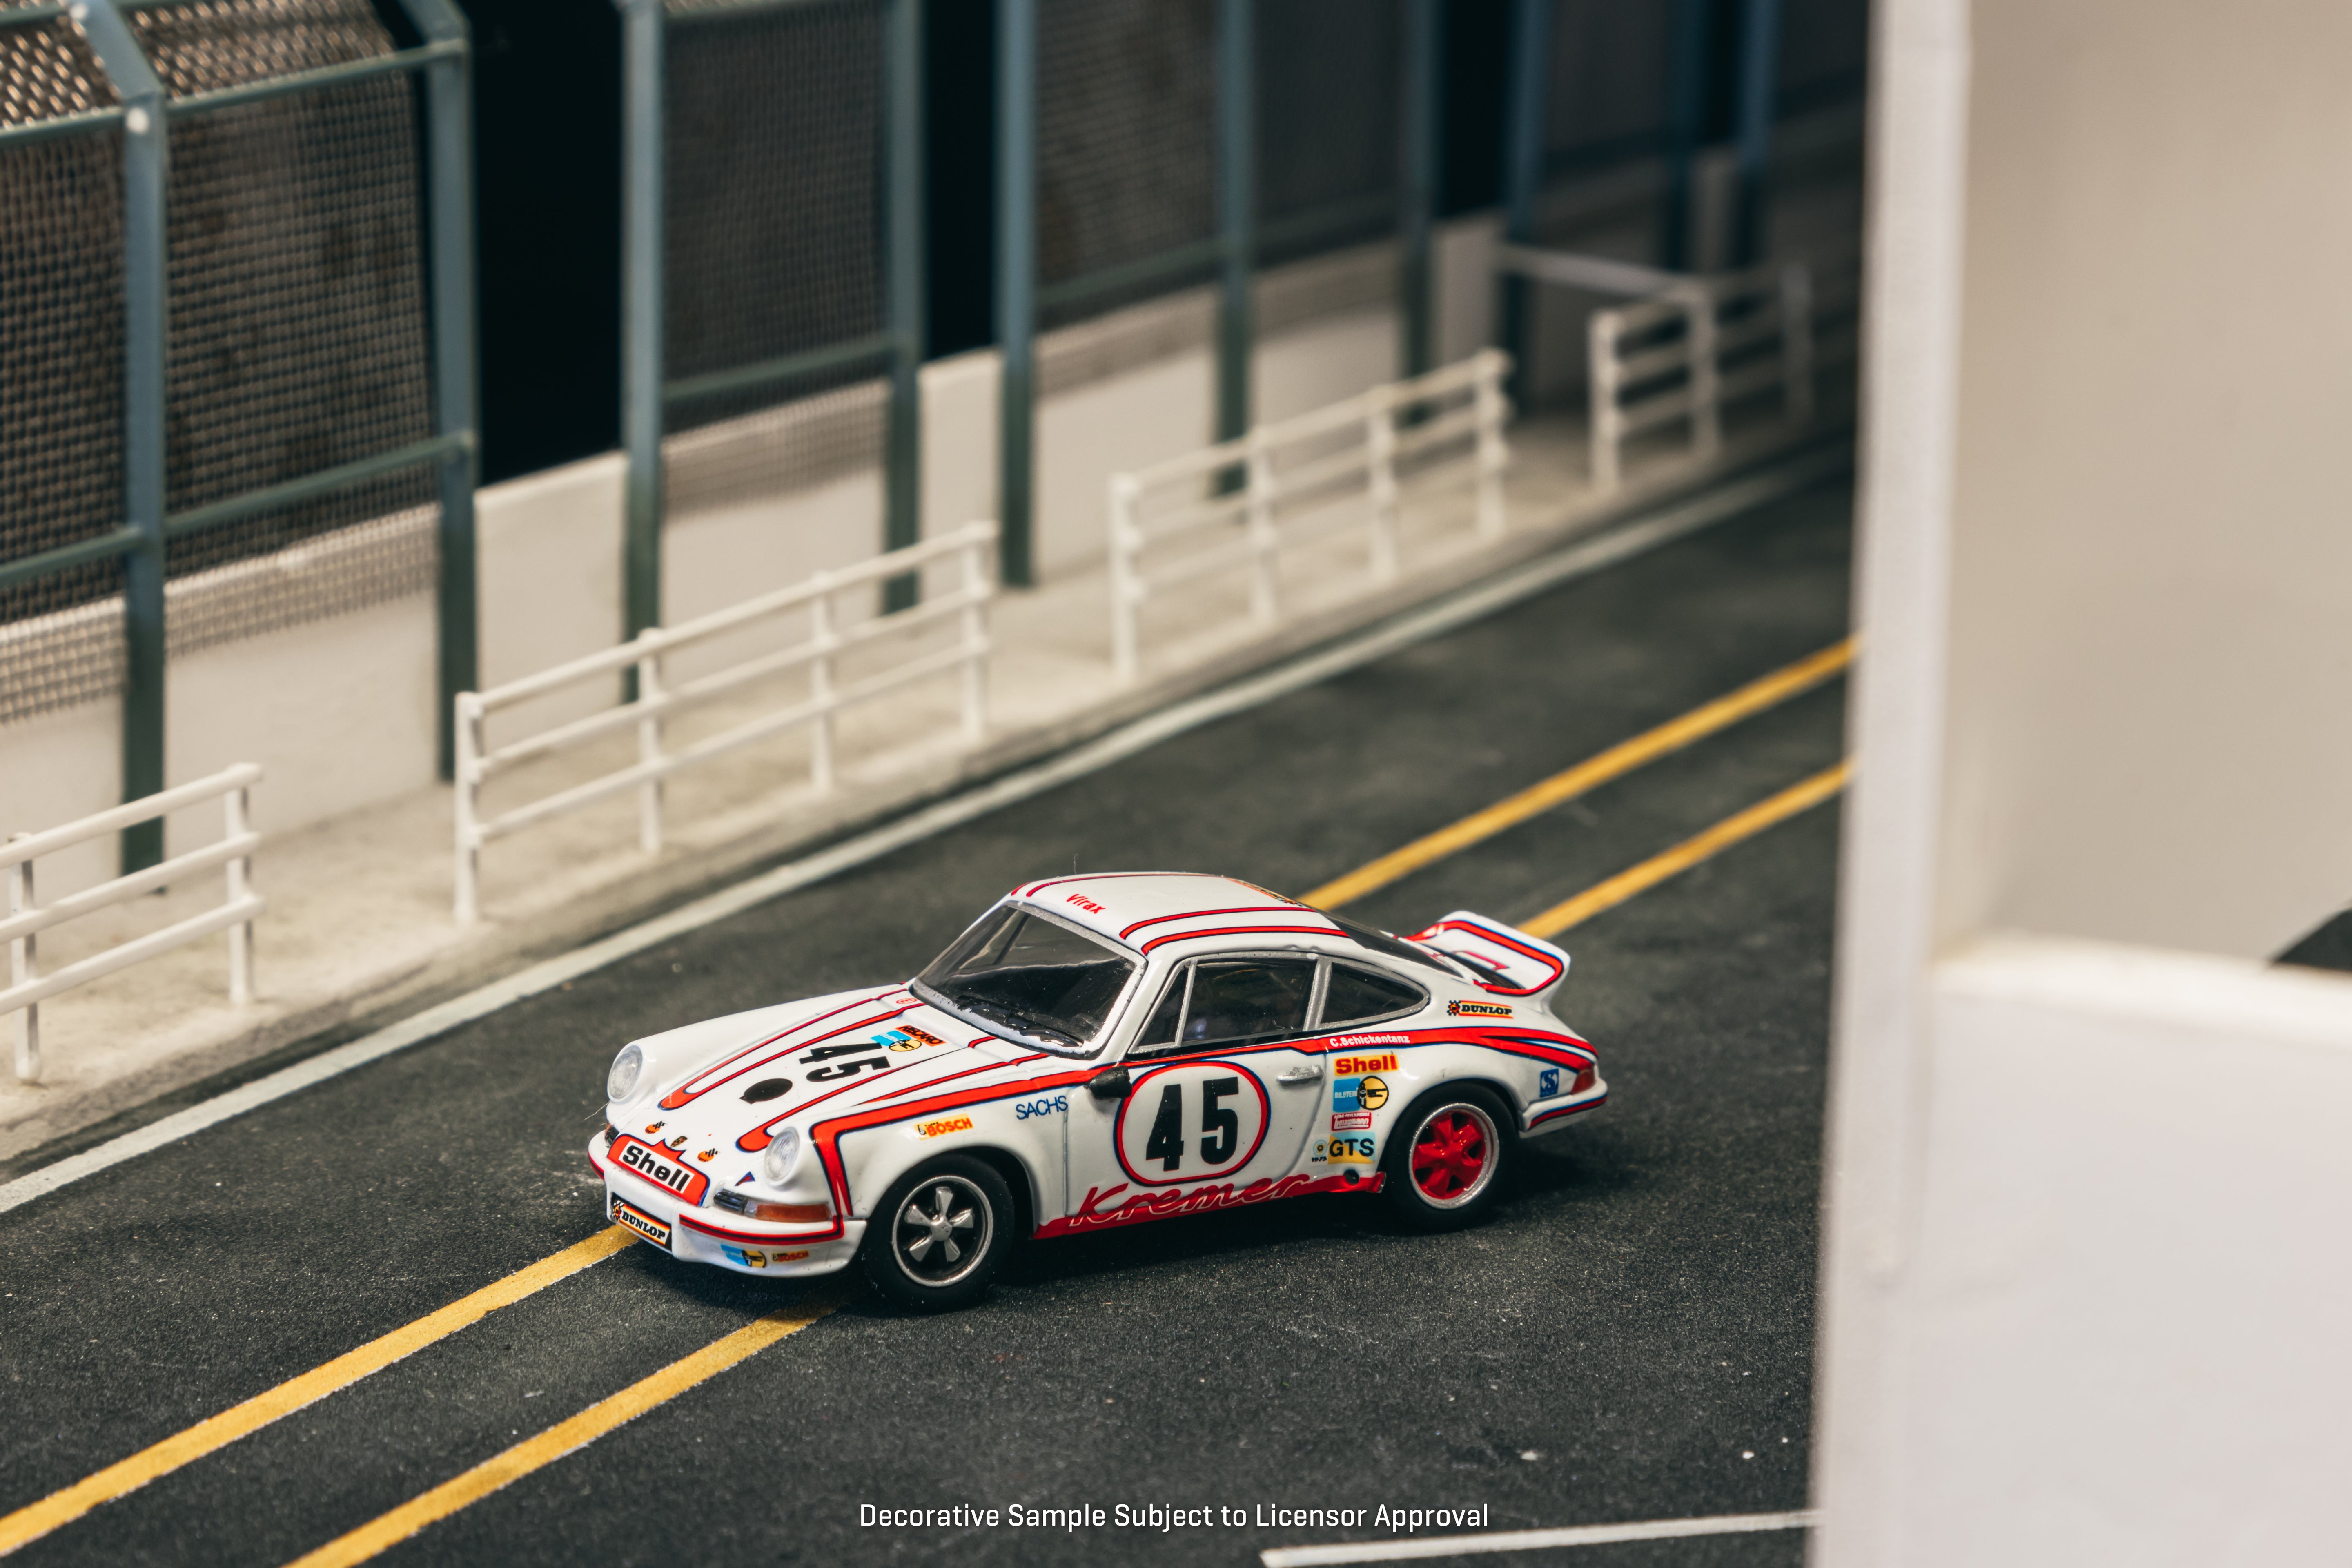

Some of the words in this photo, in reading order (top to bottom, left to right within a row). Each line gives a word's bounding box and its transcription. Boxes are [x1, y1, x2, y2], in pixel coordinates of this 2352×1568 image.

[1066, 893, 1106, 914] Virax
[1461, 1004, 1512, 1015] DUNLOP
[898, 1025, 943, 1044] RECARO
[799, 1042, 891, 1082] 45
[1336, 1055, 1398, 1074] Shell
[1016, 1095, 1069, 1120] SACHS
[926, 1118, 973, 1137] BOSCH
[1146, 1076, 1239, 1172] 45
[1330, 1138, 1374, 1157] GTS
[622, 1145, 690, 1192] Shell
[1069, 1174, 1310, 1227] Kremer
[621, 1212, 666, 1240] DUNLOP
[779, 1251, 809, 1262] BOSCH
